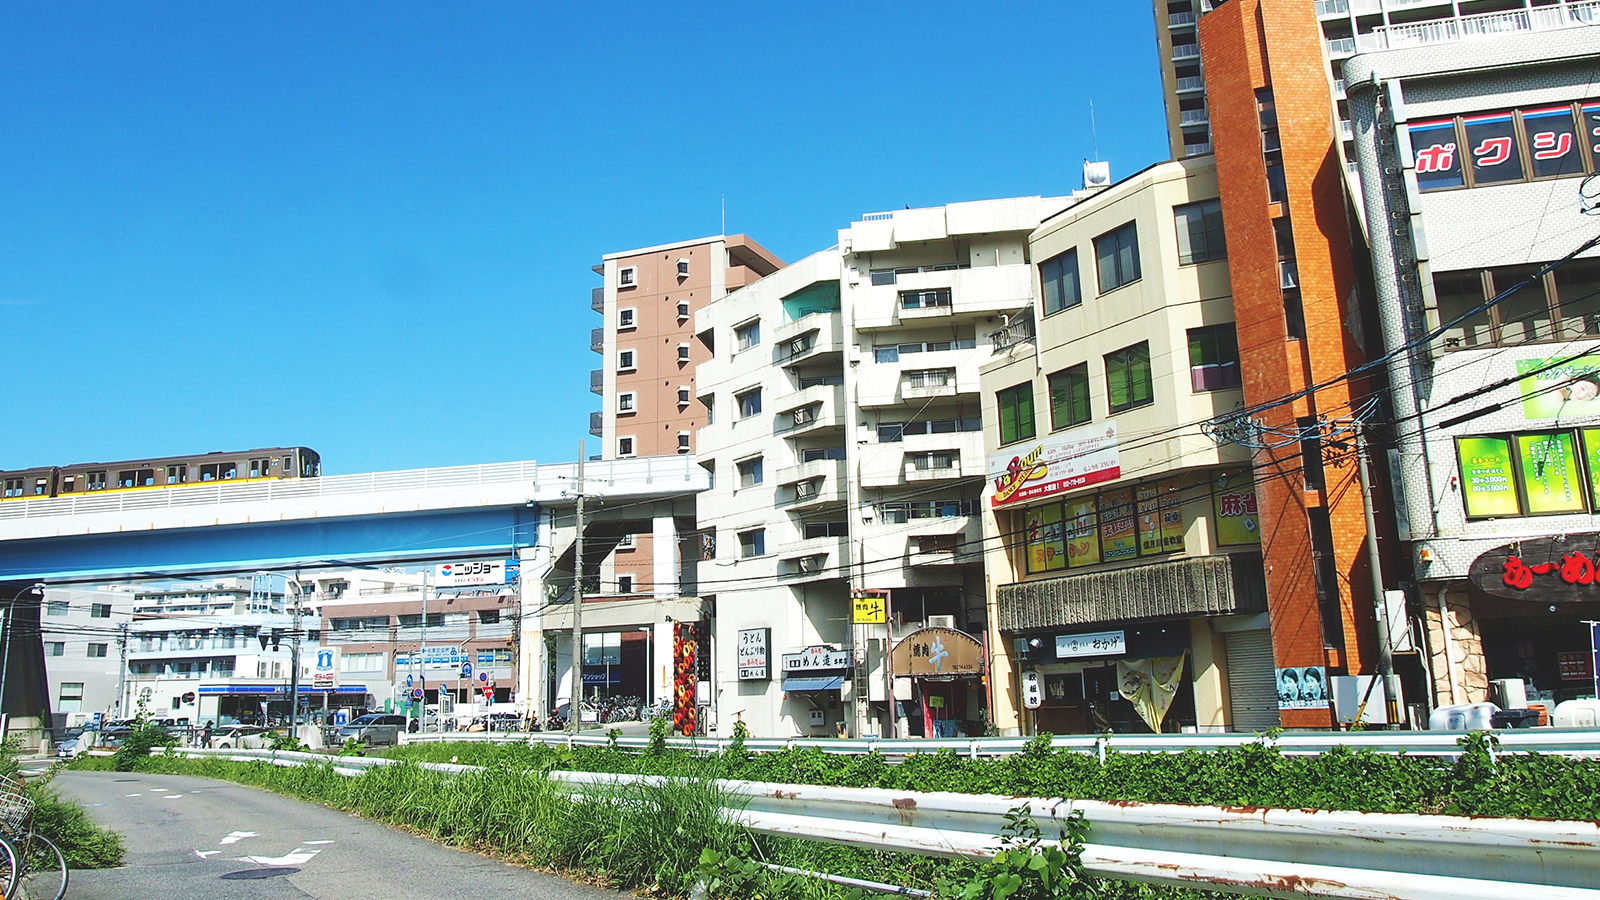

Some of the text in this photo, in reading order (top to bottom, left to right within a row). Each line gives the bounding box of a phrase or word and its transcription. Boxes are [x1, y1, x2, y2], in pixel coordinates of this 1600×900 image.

[454, 562, 500, 576] ニッショー
[867, 601, 883, 621] 牛
[1092, 635, 1121, 651] おかげ
[928, 636, 949, 672] 牛
[1028, 673, 1038, 705] 鉄板焼
